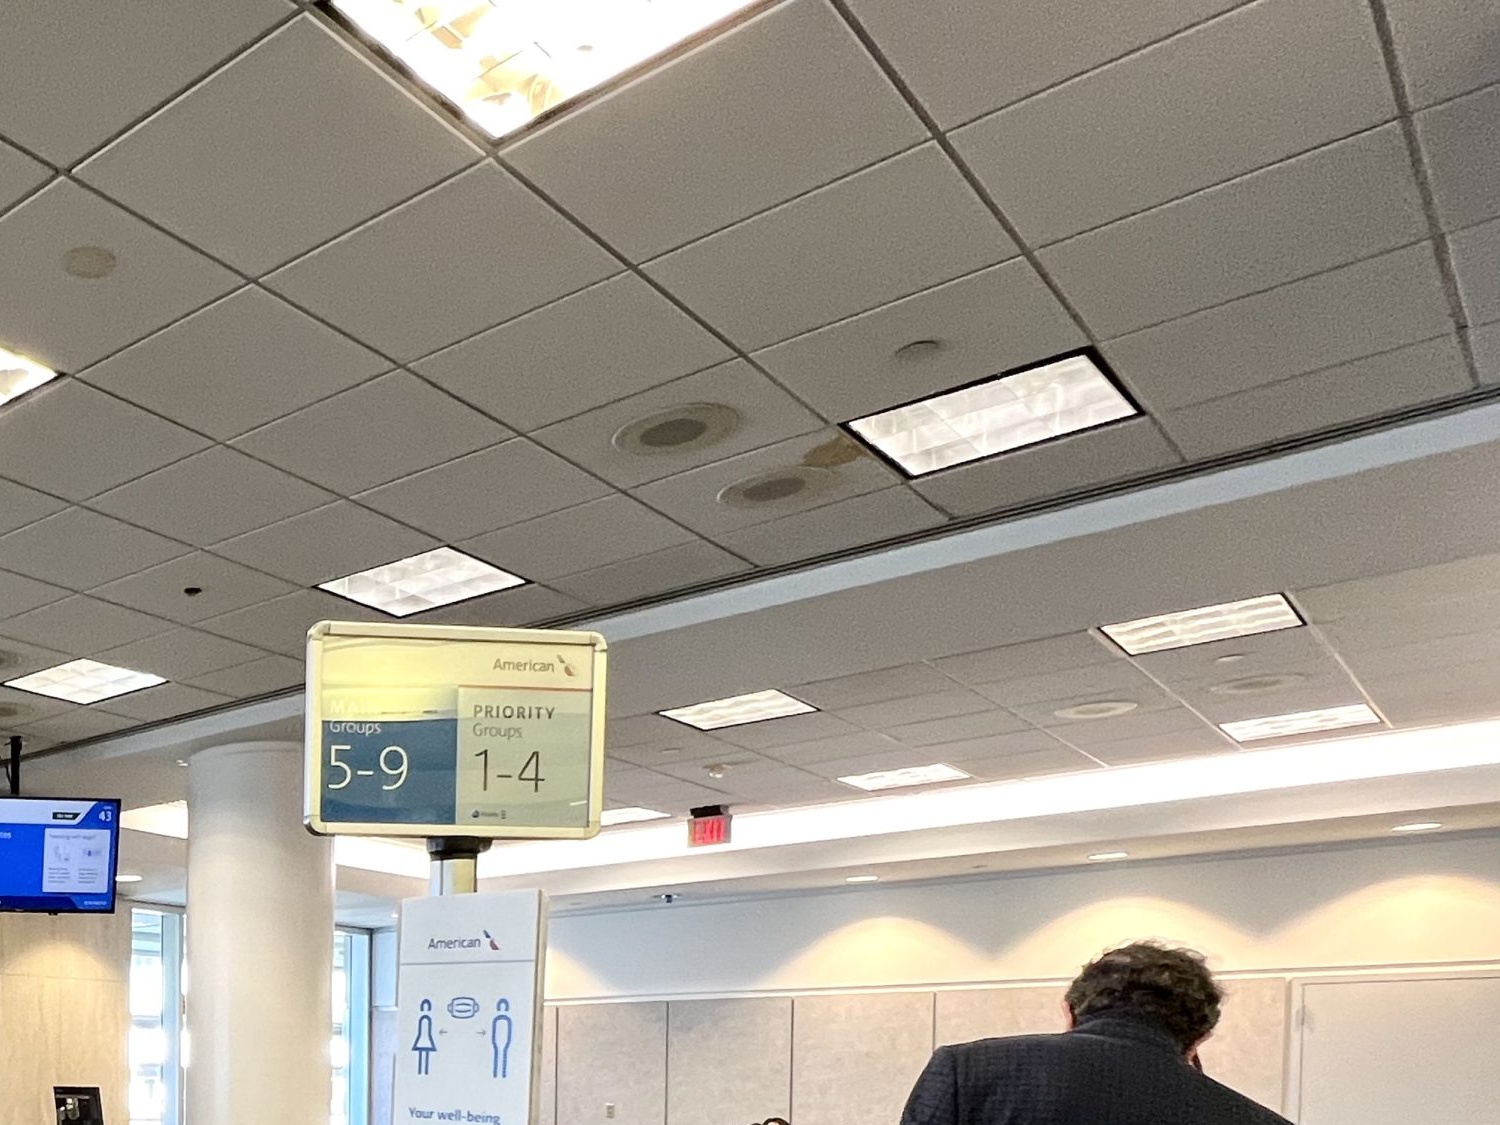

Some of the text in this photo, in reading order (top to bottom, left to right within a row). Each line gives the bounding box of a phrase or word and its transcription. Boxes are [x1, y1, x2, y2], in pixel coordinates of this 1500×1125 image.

[493, 658, 555, 673] American
[473, 704, 556, 720] PRIORITY
[329, 720, 382, 736] Groups
[472, 722, 523, 740] Groups
[327, 744, 408, 790] 5-9
[474, 749, 546, 793] 1-4
[98, 811, 112, 821] 43
[427, 938, 481, 950] American
[408, 1107, 434, 1119] Your
